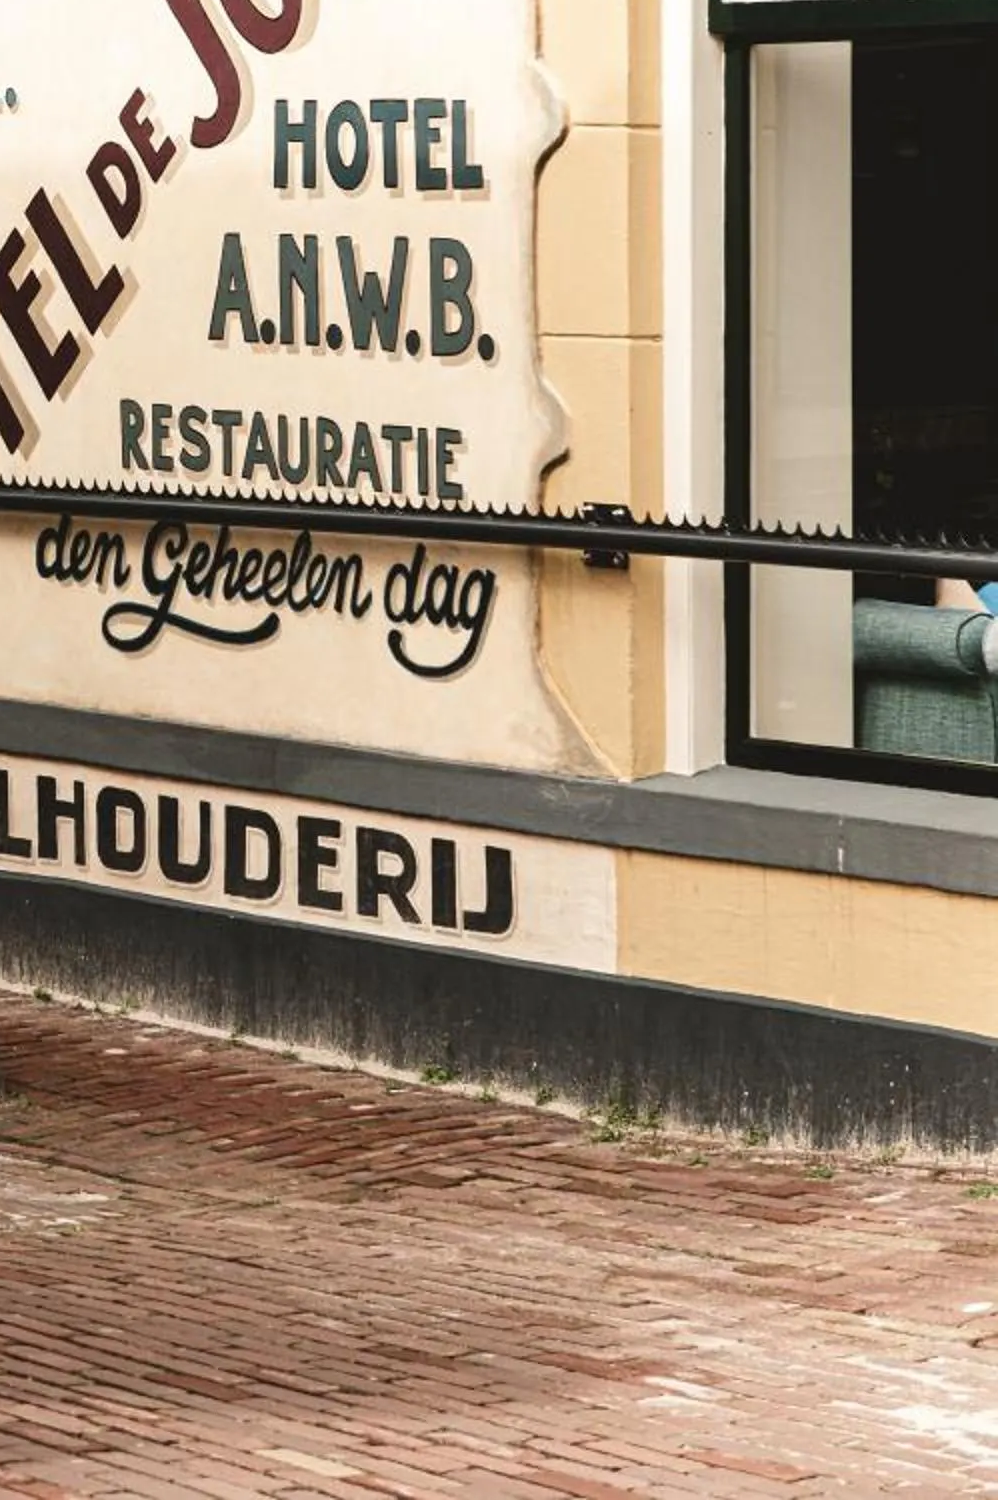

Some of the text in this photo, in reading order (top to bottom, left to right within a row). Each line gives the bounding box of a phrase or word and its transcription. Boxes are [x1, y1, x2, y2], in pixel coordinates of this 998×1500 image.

[85, 87, 177, 241] DE
[273, 97, 485, 193] HOTEL
[207, 231, 496, 363] A.N.W.B.
[119, 397, 464, 500] RESTAURATIE
[35, 512, 131, 588] den
[384, 542, 496, 678] dag
